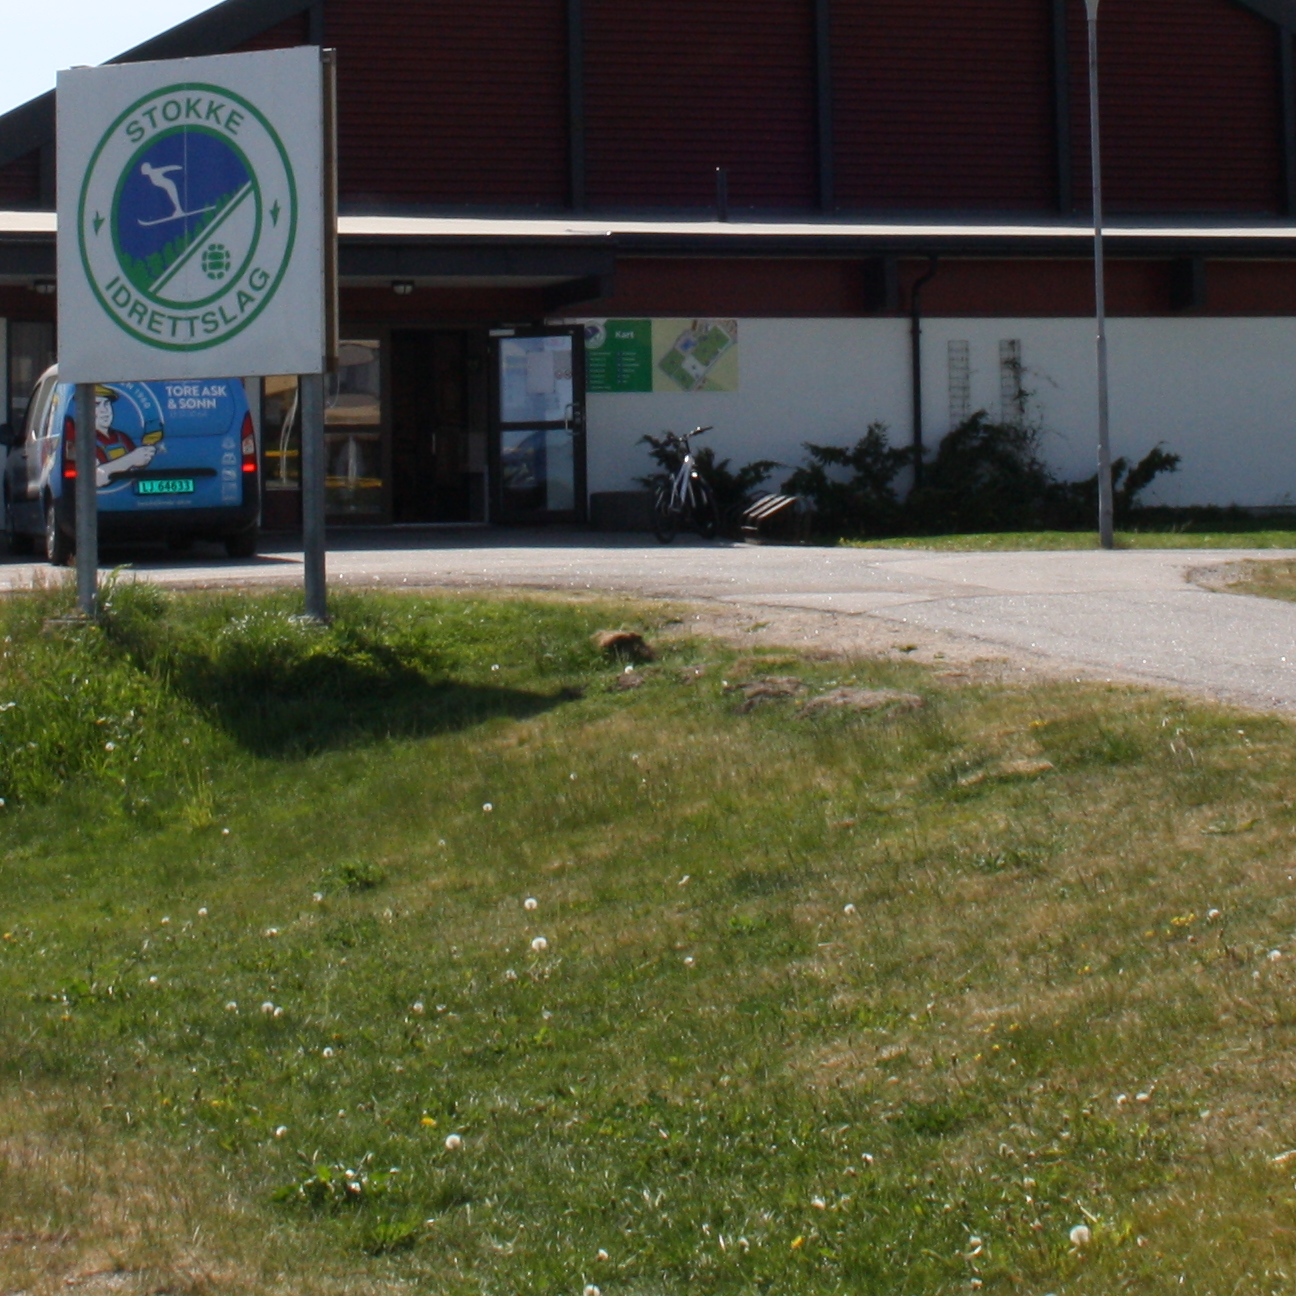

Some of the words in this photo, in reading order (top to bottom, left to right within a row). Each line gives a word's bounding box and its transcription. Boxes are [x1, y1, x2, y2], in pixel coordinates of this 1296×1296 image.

[125, 97, 245, 143] STOKKE
[104, 266, 271, 338] IDRETTSLAG
[165, 385, 199, 397] TORE
[201, 385, 226, 396] ASK
[167, 399, 177, 410] &
[178, 398, 217, 409] SONN
